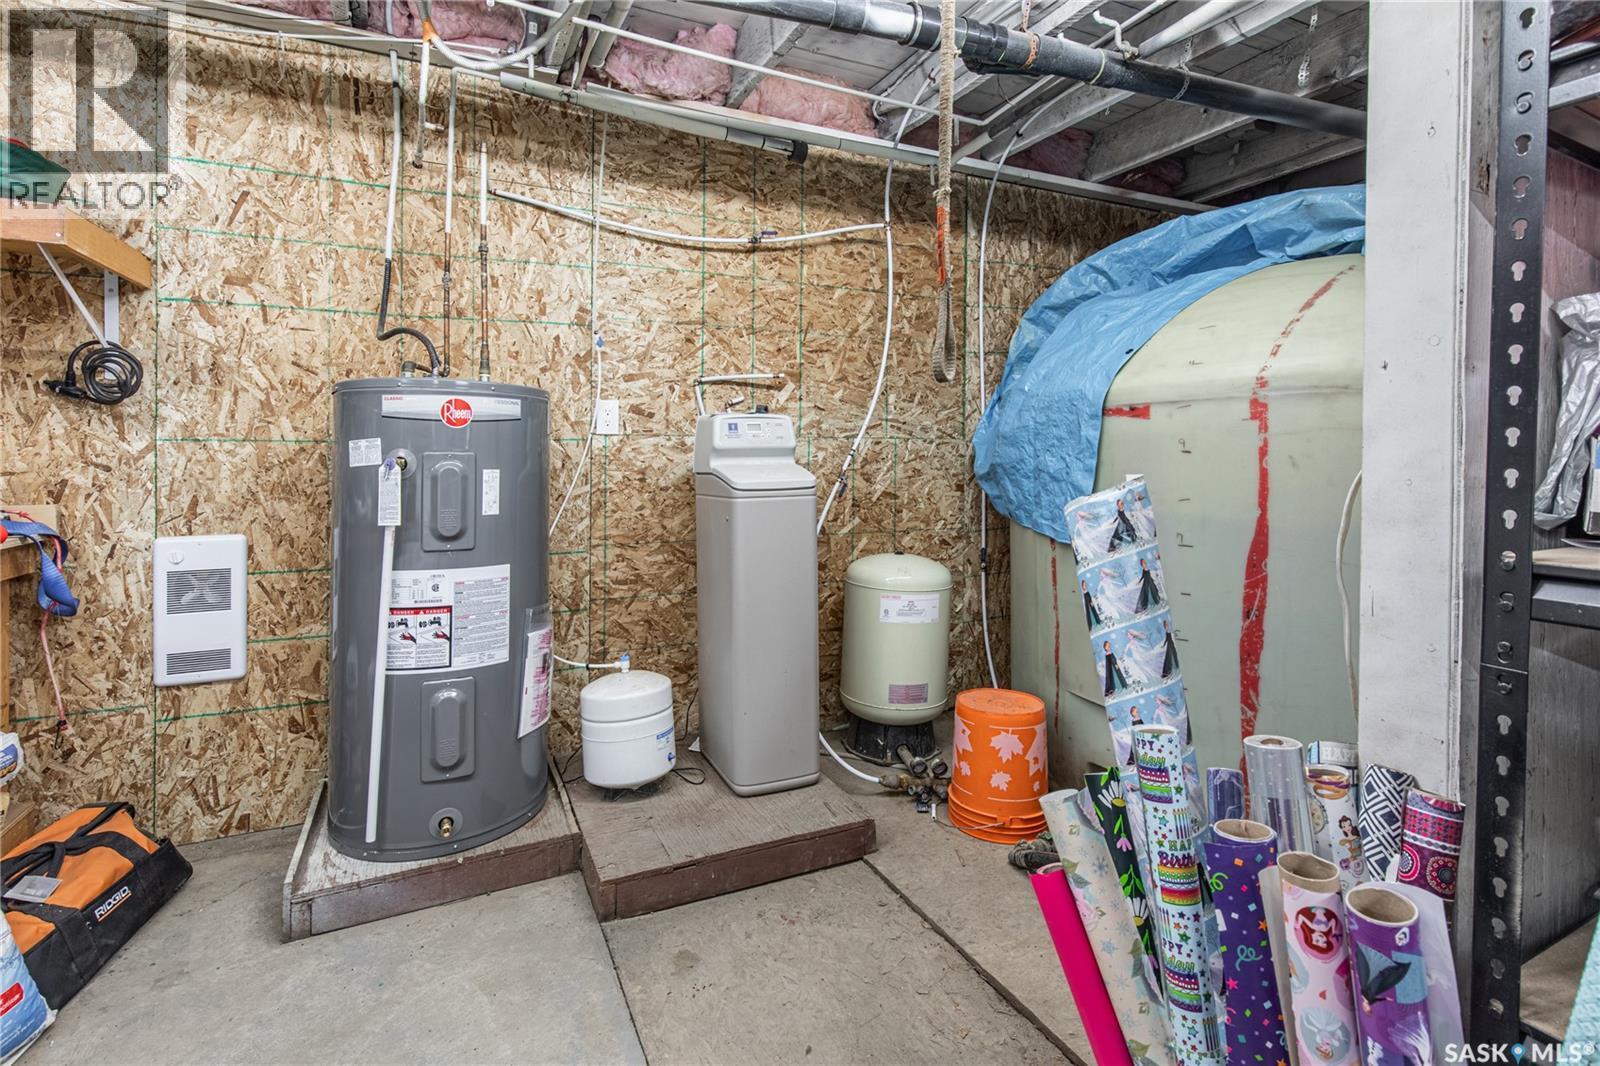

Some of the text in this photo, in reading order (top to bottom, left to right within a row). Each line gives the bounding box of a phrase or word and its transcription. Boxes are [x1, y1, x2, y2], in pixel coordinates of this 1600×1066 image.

[443, 399, 472, 424] Rheem
[1136, 737, 1155, 751] PPY
[1157, 850, 1196, 869] Birth
[95, 886, 129, 919] RIDGID
[1162, 937, 1183, 955] PPY
